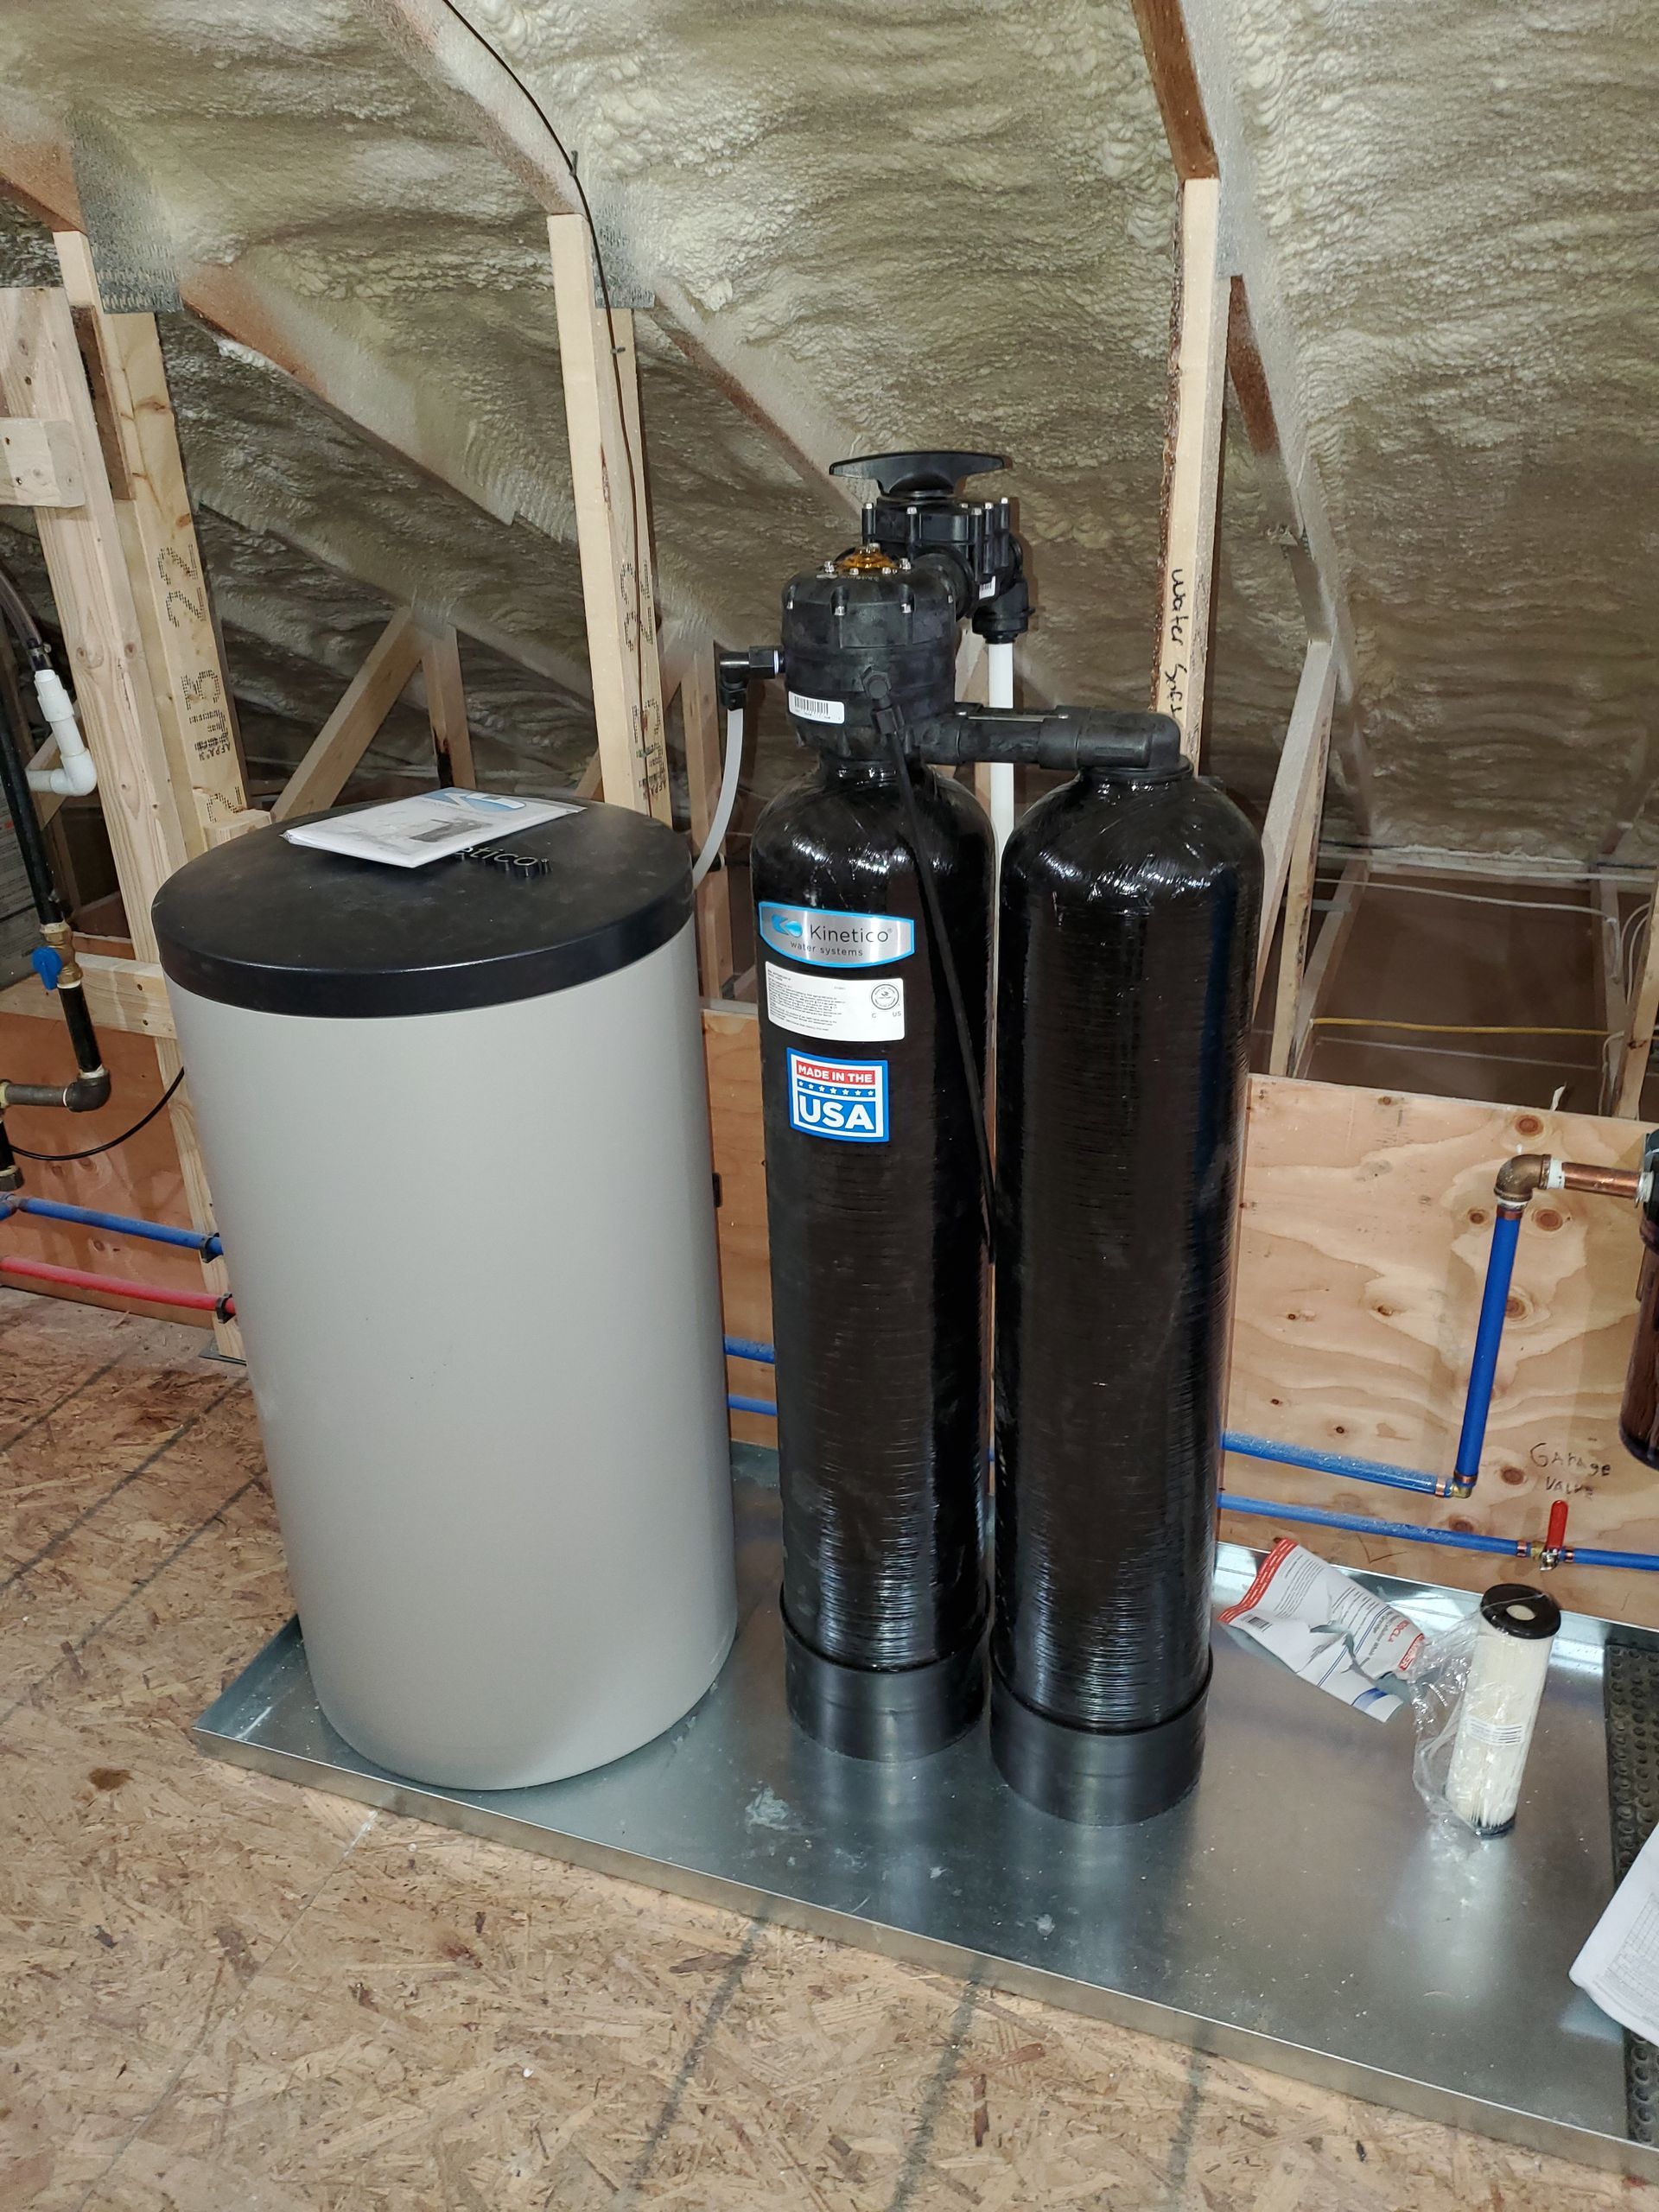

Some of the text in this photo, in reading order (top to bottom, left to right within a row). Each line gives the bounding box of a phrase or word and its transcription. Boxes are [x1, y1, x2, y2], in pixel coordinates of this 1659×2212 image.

[790, 941, 864, 957] water systems
[798, 1064, 874, 1084] MADE IN THE
[798, 1093, 875, 1130] USA
